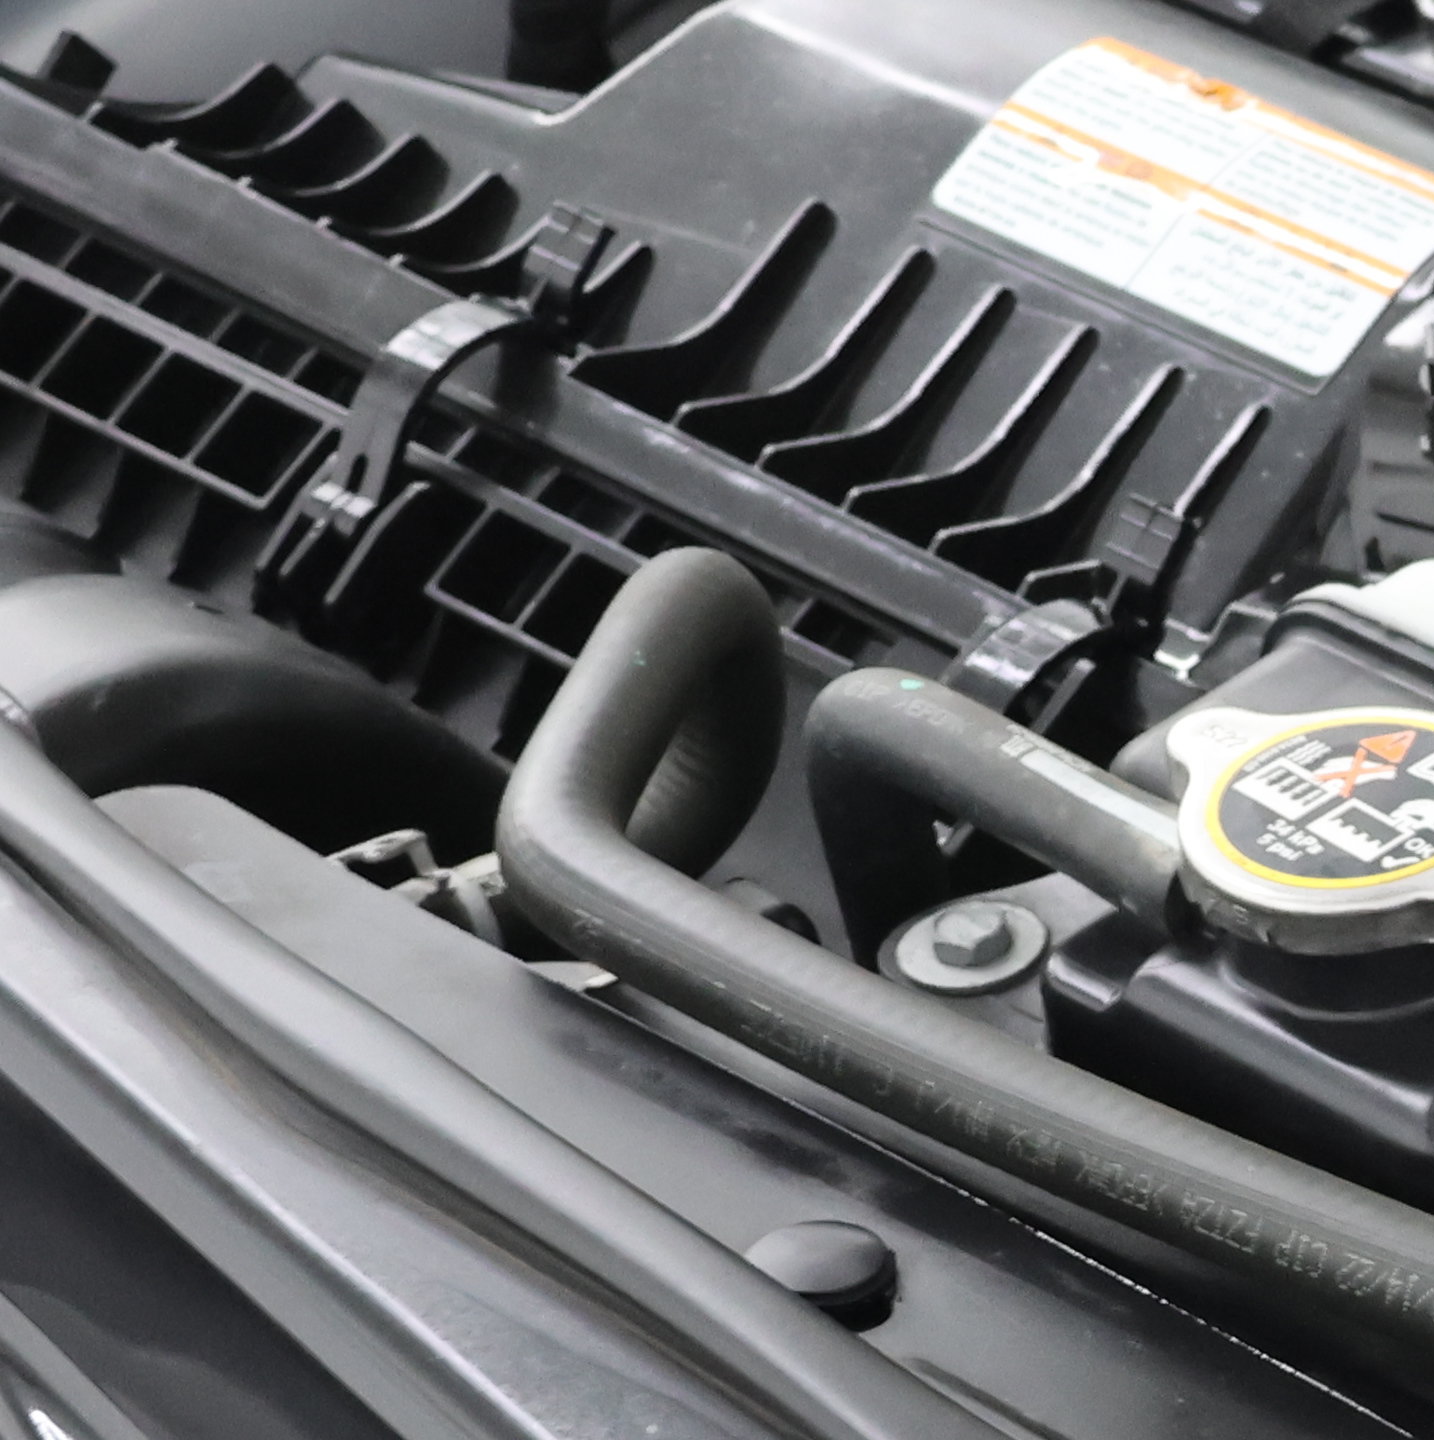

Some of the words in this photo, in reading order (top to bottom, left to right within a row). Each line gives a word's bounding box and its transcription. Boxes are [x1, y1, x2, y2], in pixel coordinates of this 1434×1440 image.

[1266, 820, 1290, 838] 34
[1287, 829, 1325, 855] kPa
[1269, 839, 1305, 861] psi
